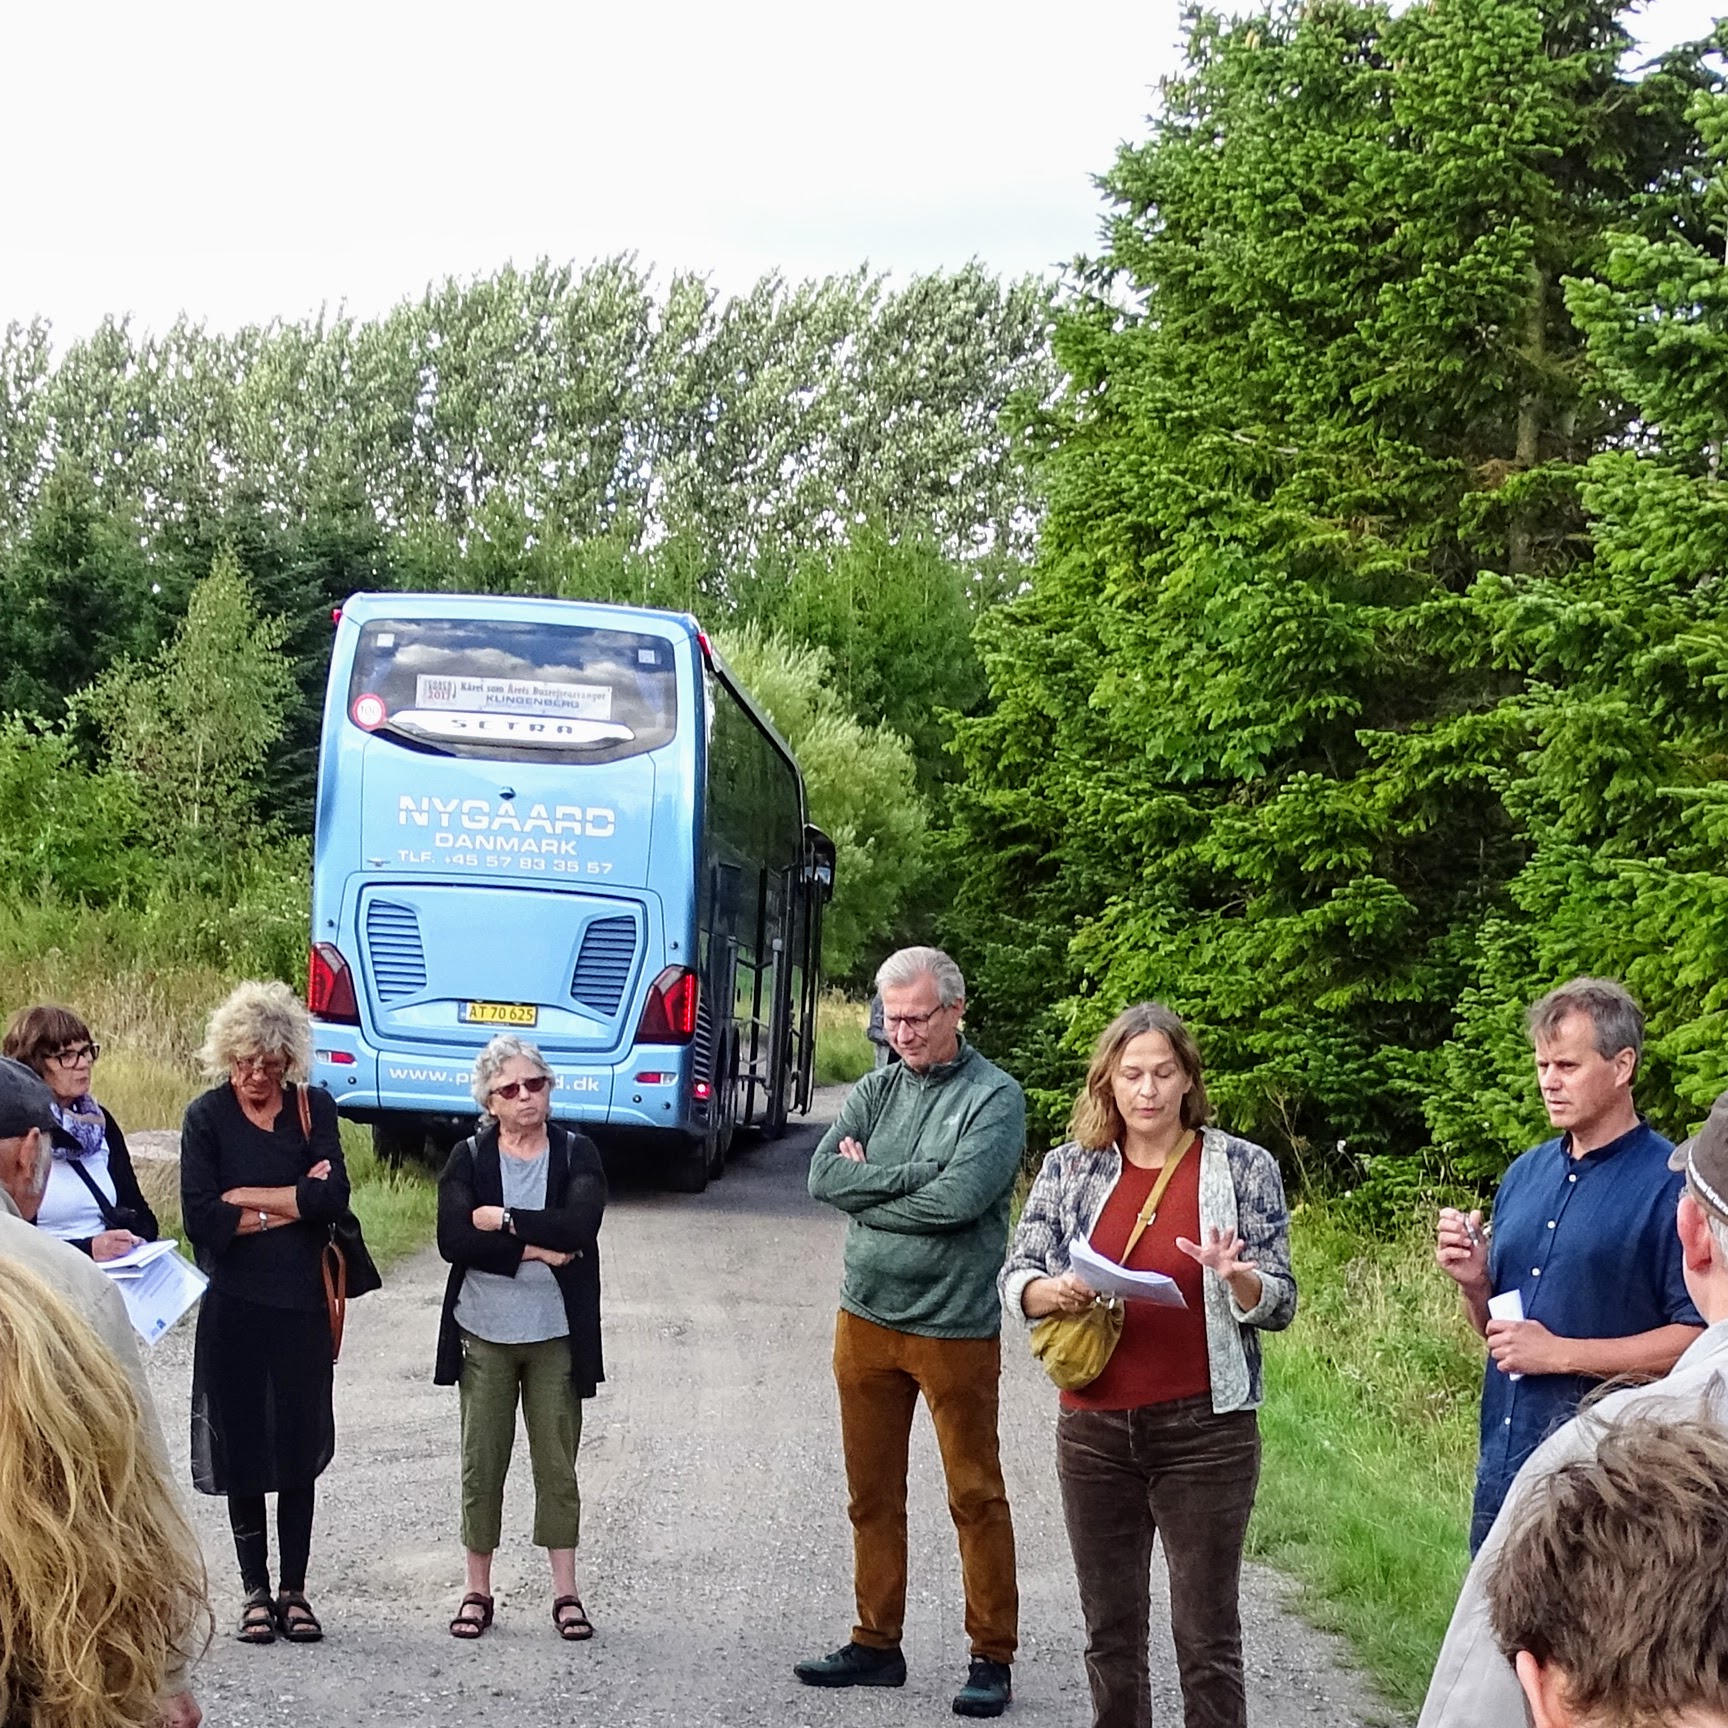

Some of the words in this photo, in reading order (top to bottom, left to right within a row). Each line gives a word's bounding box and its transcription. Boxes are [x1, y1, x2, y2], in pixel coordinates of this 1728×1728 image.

[486, 694, 580, 709] KLINGENBERG
[451, 719, 573, 735] SETRA
[398, 795, 616, 837] NYGAARD
[435, 832, 578, 856] DANMARK
[398, 850, 435, 864] TLF.
[444, 853, 479, 867] +45
[486, 855, 512, 868] 57
[553, 859, 580, 873] 35
[587, 861, 614, 875] 57
[469, 1004, 488, 1019] AT
[490, 1006, 507, 1020] 70
[509, 1007, 534, 1022] 625
